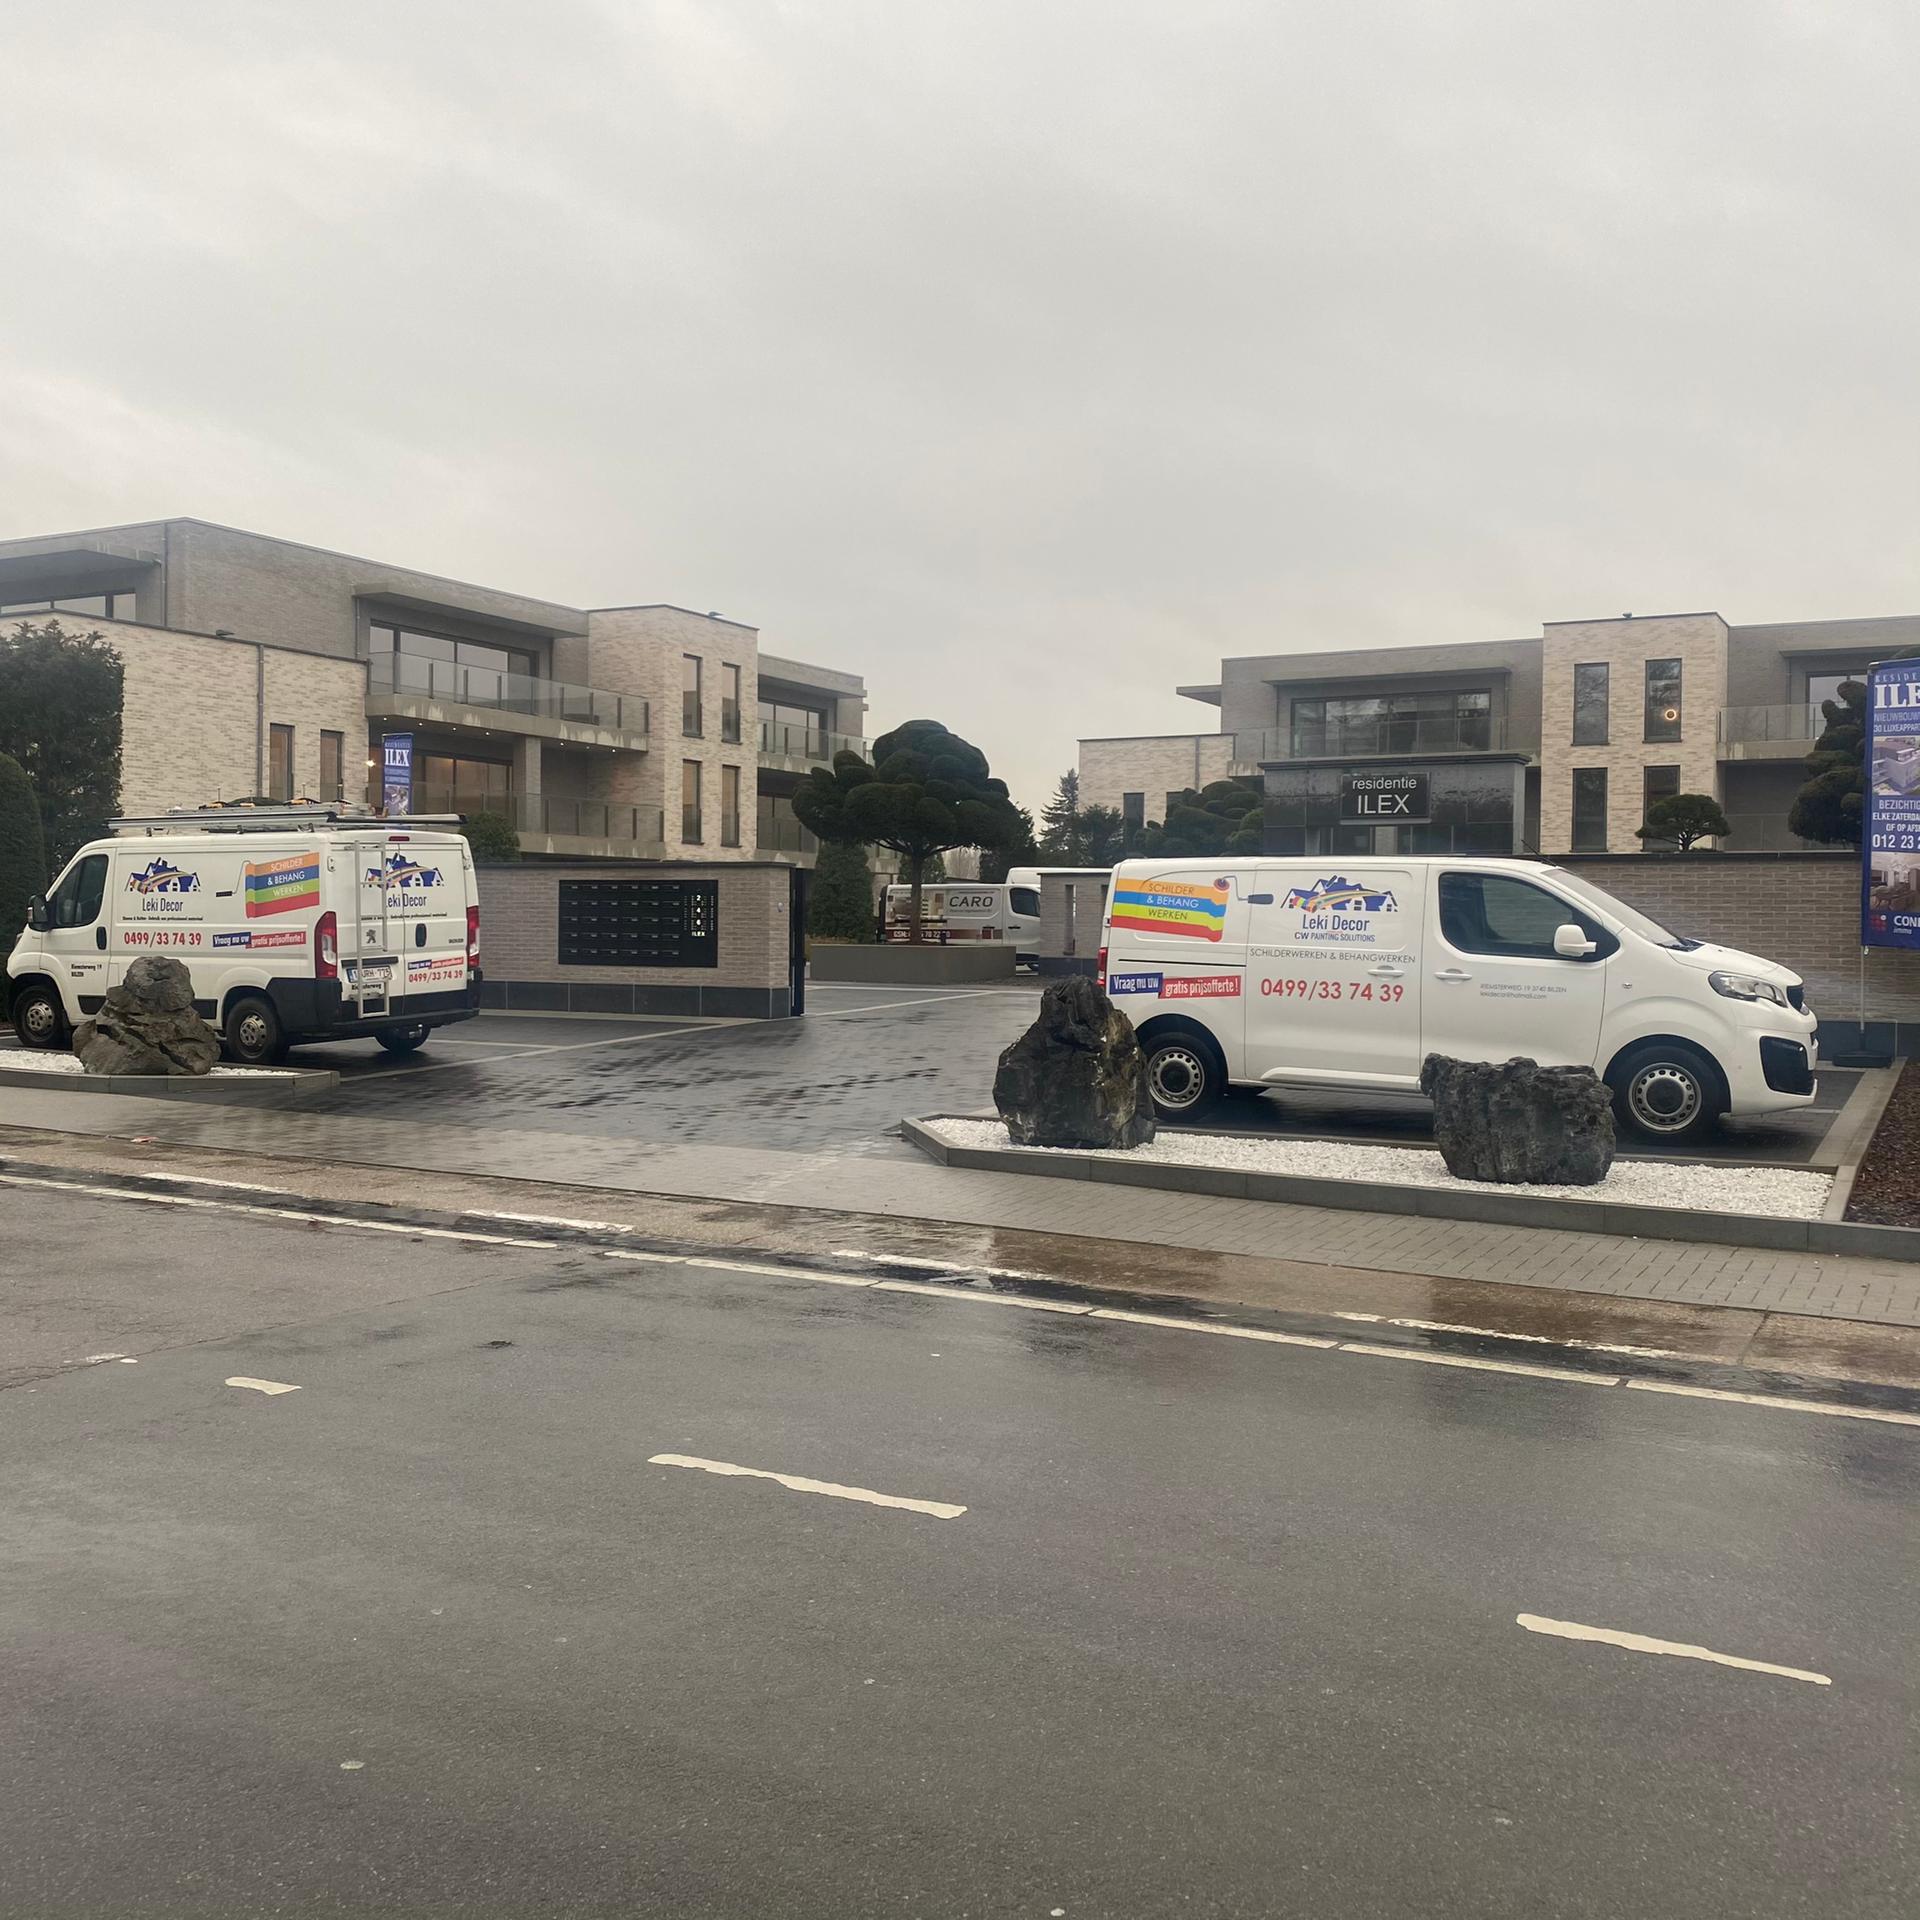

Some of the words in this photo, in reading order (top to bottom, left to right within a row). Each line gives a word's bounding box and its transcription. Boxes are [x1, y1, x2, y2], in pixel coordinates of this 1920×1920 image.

[384, 748, 410, 767] ILEX
[1352, 776, 1417, 790] residentie
[1357, 793, 1410, 814] ILEX
[1886, 823, 1896, 831] OF
[1872, 834, 1896, 848] 012
[1900, 835, 1914, 849] 23
[271, 858, 304, 872] SCHILDER
[267, 877, 273, 885] &
[275, 871, 305, 884] BEHANG
[272, 884, 304, 896] WERKEN
[1148, 883, 1194, 895] SCHILDER
[142, 898, 158, 911] Leki
[160, 898, 183, 911] Decor
[386, 894, 401, 908] eki
[403, 893, 427, 907] Decor
[949, 896, 993, 907] CARO
[1146, 895, 1154, 903] &
[1157, 896, 1199, 908] BEHANG
[1148, 909, 1189, 920] WERKEN
[1302, 914, 1328, 930] Leki
[1332, 915, 1370, 931] Decor
[124, 932, 169, 948] 0499/33
[172, 932, 185, 945] 74
[189, 932, 202, 945] 39
[1294, 932, 1310, 940] CW
[1310, 932, 1339, 941] PAINTING
[1340, 934, 1376, 942] SOLUTIONS
[1250, 948, 1327, 959] SCHILDERWERKEN
[1329, 952, 1337, 960] &
[1339, 952, 1416, 964] BEHANGWERKEN
[409, 971, 441, 983] 0499/33
[443, 971, 452, 979] 74
[454, 970, 463, 978] 39
[1113, 976, 1136, 991] Vraag
[1136, 980, 1146, 988] nu
[1147, 979, 1159, 988] uw
[1165, 980, 1188, 997] gratis
[1260, 978, 1342, 1001] 0499/33
[1350, 983, 1373, 1001] 74
[1379, 984, 1404, 1002] 39
